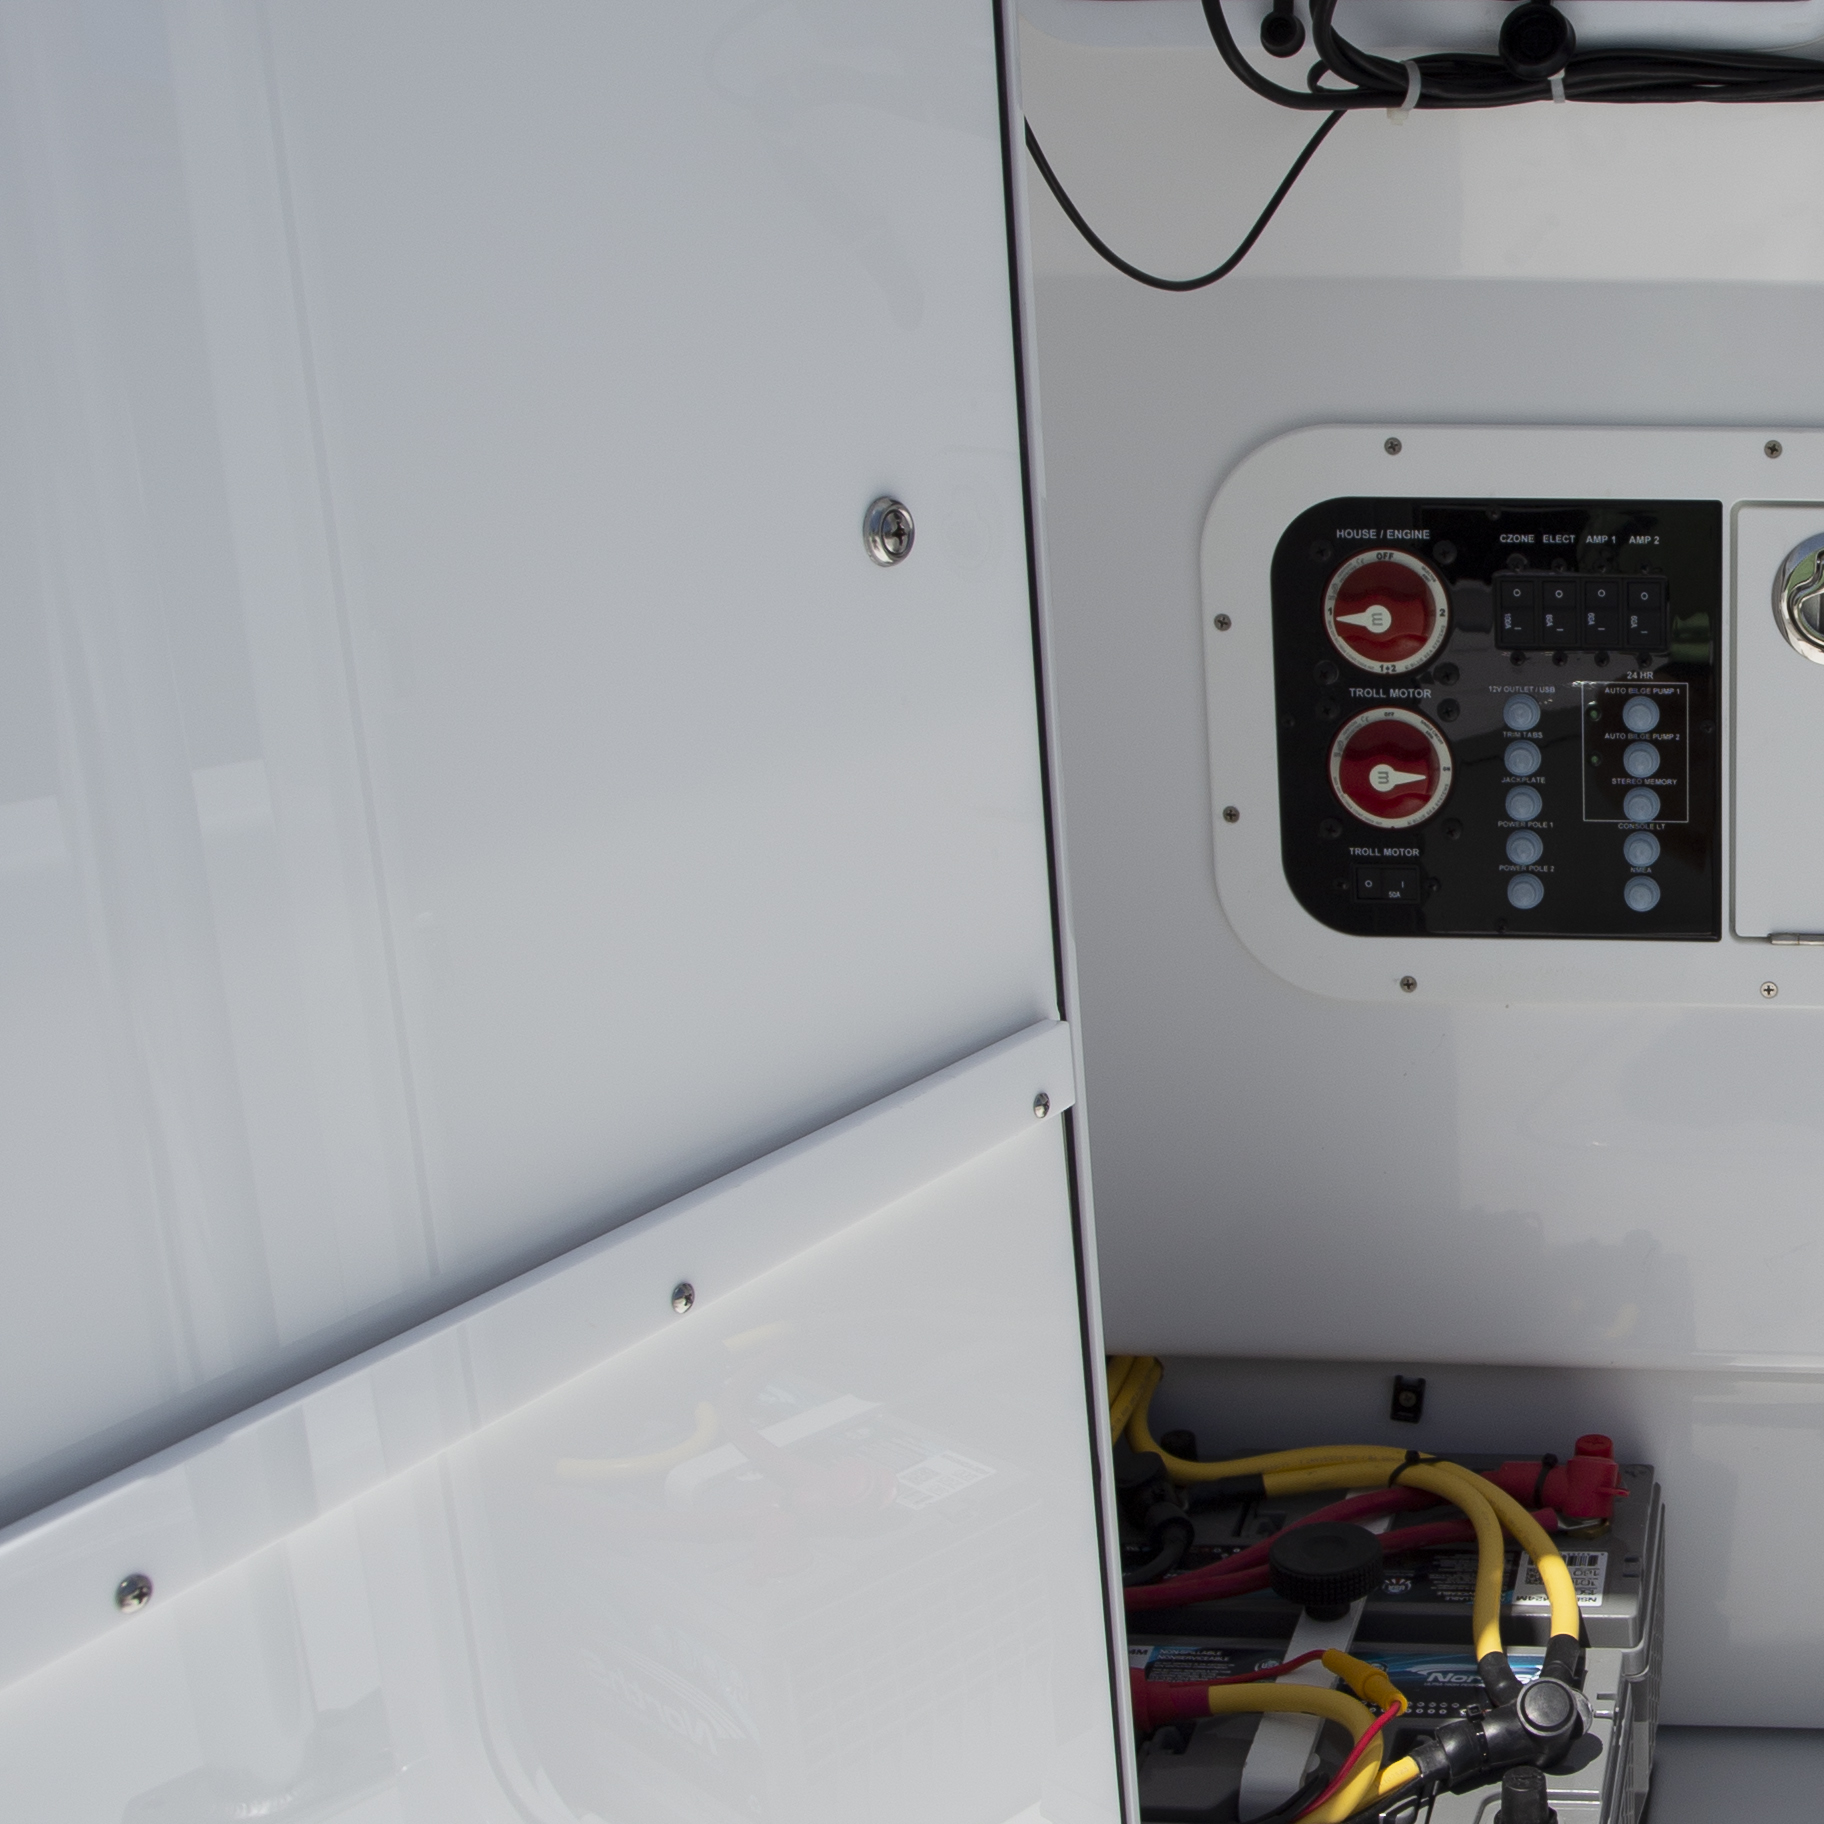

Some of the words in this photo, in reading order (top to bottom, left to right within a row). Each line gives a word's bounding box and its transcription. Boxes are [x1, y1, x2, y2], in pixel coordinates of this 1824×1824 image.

[1336, 529, 1377, 539] HOUSE
[1379, 529, 1384, 539] /
[1386, 530, 1430, 540] ENGINE
[1499, 534, 1535, 543] CZONE
[1542, 534, 1576, 543] ELECT
[1585, 535, 1610, 544] AMP
[1628, 536, 1652, 545] AMP
[1654, 536, 1660, 545] 2
[1376, 552, 1394, 561] OFF
[1327, 607, 1333, 616] 1
[1439, 608, 1446, 617] 2
[1626, 671, 1638, 679] 24
[1639, 671, 1654, 680] HR
[1349, 688, 1386, 698] TROLL
[1389, 688, 1432, 699] MOTOR
[1488, 685, 1502, 693] 12V
[1503, 685, 1535, 693] OUTLET
[1539, 685, 1555, 693] USB
[1604, 687, 1626, 695] AUTO
[1628, 687, 1651, 695] BILGE
[1653, 687, 1675, 695] PUMP
[1501, 776, 1546, 784] JACKPLATE
[1617, 822, 1655, 830] CONSOLE
[1349, 847, 1381, 856] TROLL
[1383, 847, 1420, 857] MOTOR
[1528, 865, 1549, 873] POLE
[1630, 866, 1652, 874] NMEA
